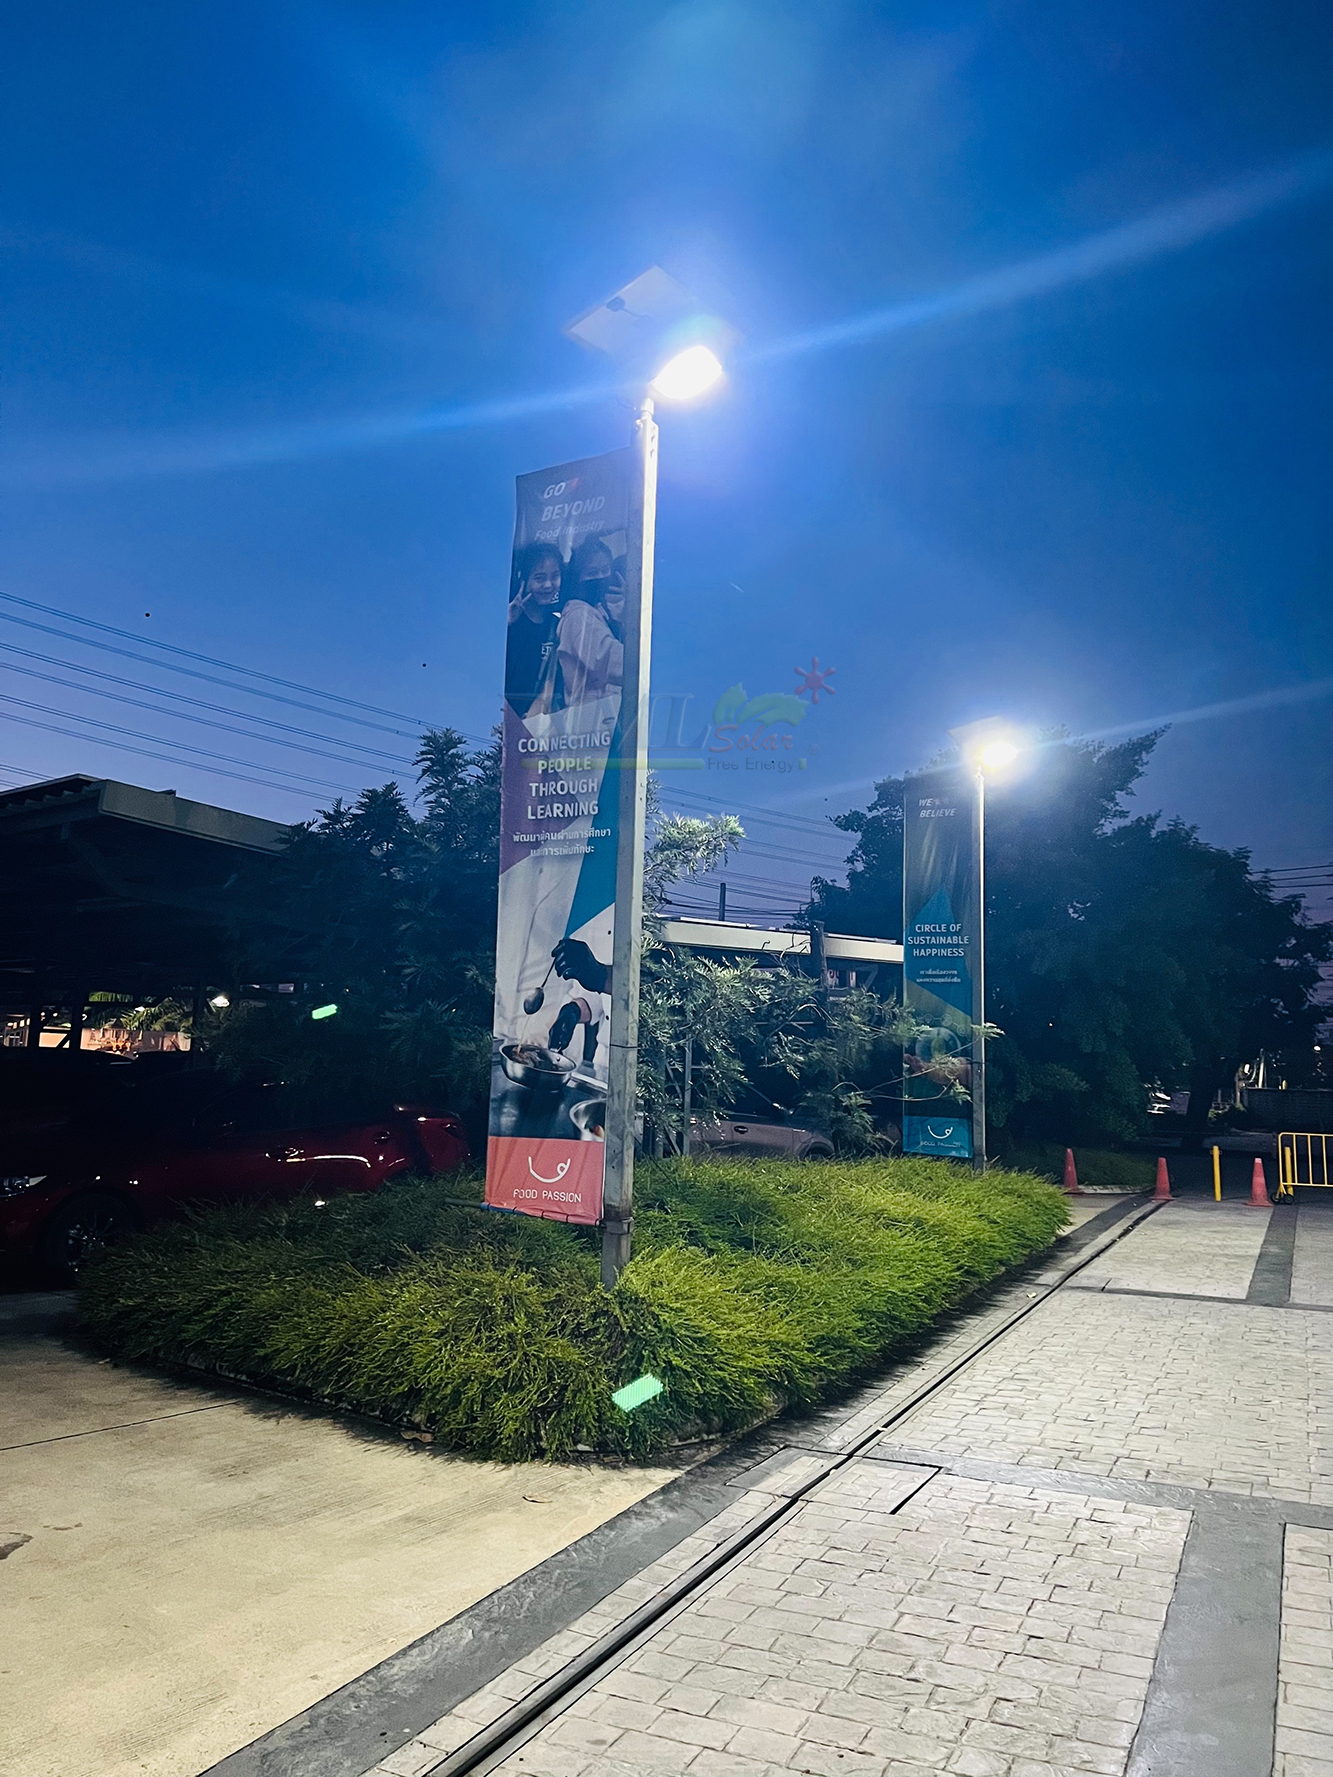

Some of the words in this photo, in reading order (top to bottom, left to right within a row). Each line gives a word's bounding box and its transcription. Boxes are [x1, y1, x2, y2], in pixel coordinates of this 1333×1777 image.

[544, 482, 566, 499] GO
[541, 496, 606, 522] BEYOND
[534, 526, 561, 541] Food
[518, 731, 611, 753] CONNECTING
[538, 756, 592, 775] PEOPLE
[529, 778, 598, 797] THROUGH
[527, 800, 599, 819] LEARNING
[919, 798, 933, 807] WE
[920, 808, 957, 818] BELIEVE
[915, 923, 947, 933] CIRCLE
[949, 923, 962, 932] OF
[907, 935, 970, 945] SUSTAINABLE
[913, 948, 965, 957] HAPPINESS
[513, 1188, 538, 1199] FOOD
[542, 1190, 582, 1203] PASSION
